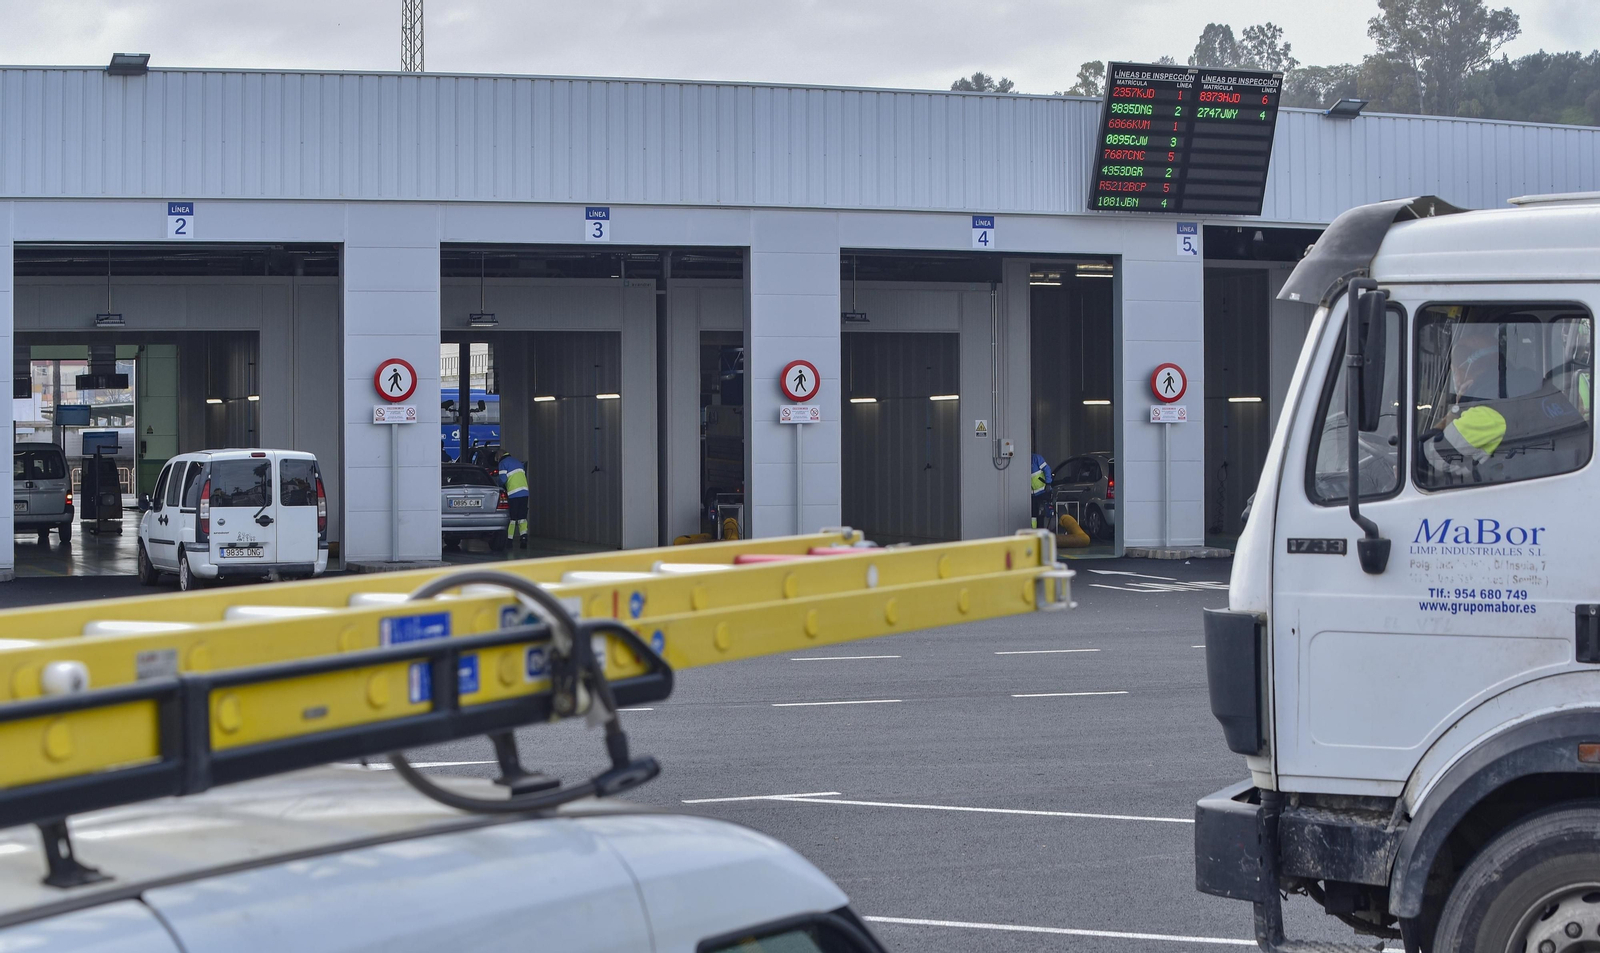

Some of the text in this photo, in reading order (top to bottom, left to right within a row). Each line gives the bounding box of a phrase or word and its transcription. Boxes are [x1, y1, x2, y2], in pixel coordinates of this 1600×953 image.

[1114, 70, 1140, 78] LÍNEAS
[1152, 72, 1195, 81] INSPECCIÓN
[1202, 74, 1226, 83] LÍNEAS
[1239, 78, 1279, 86] INSPECCIÓN
[1113, 87, 1182, 100] 2357KJD 1
[1200, 92, 1268, 105] 8373HJD 6
[1112, 103, 1181, 116] 9835DNG 2
[1197, 108, 1266, 120] 2747JWY 4
[1174, 122, 1177, 131] 1
[1106, 134, 1177, 147] 0895CJW 3
[1104, 149, 1174, 161] 7687CNC 5
[1102, 166, 1172, 177] 4353DGR 2
[1163, 183, 1170, 192] 5
[1098, 197, 1167, 208] 1081JBN 4
[175, 218, 186, 235] 2
[592, 222, 603, 238] 3
[978, 231, 989, 246] 4
[1183, 237, 1192, 252] 5
[1412, 518, 1545, 546] MaBor
[1290, 540, 1344, 551] 1733
[1441, 546, 1522, 556] INDUSTRIALES
[1454, 589, 1476, 599] 954
[1480, 589, 1501, 599] 680
[1506, 590, 1528, 600] 749
[1419, 601, 1536, 615] www.grupomabor.es
